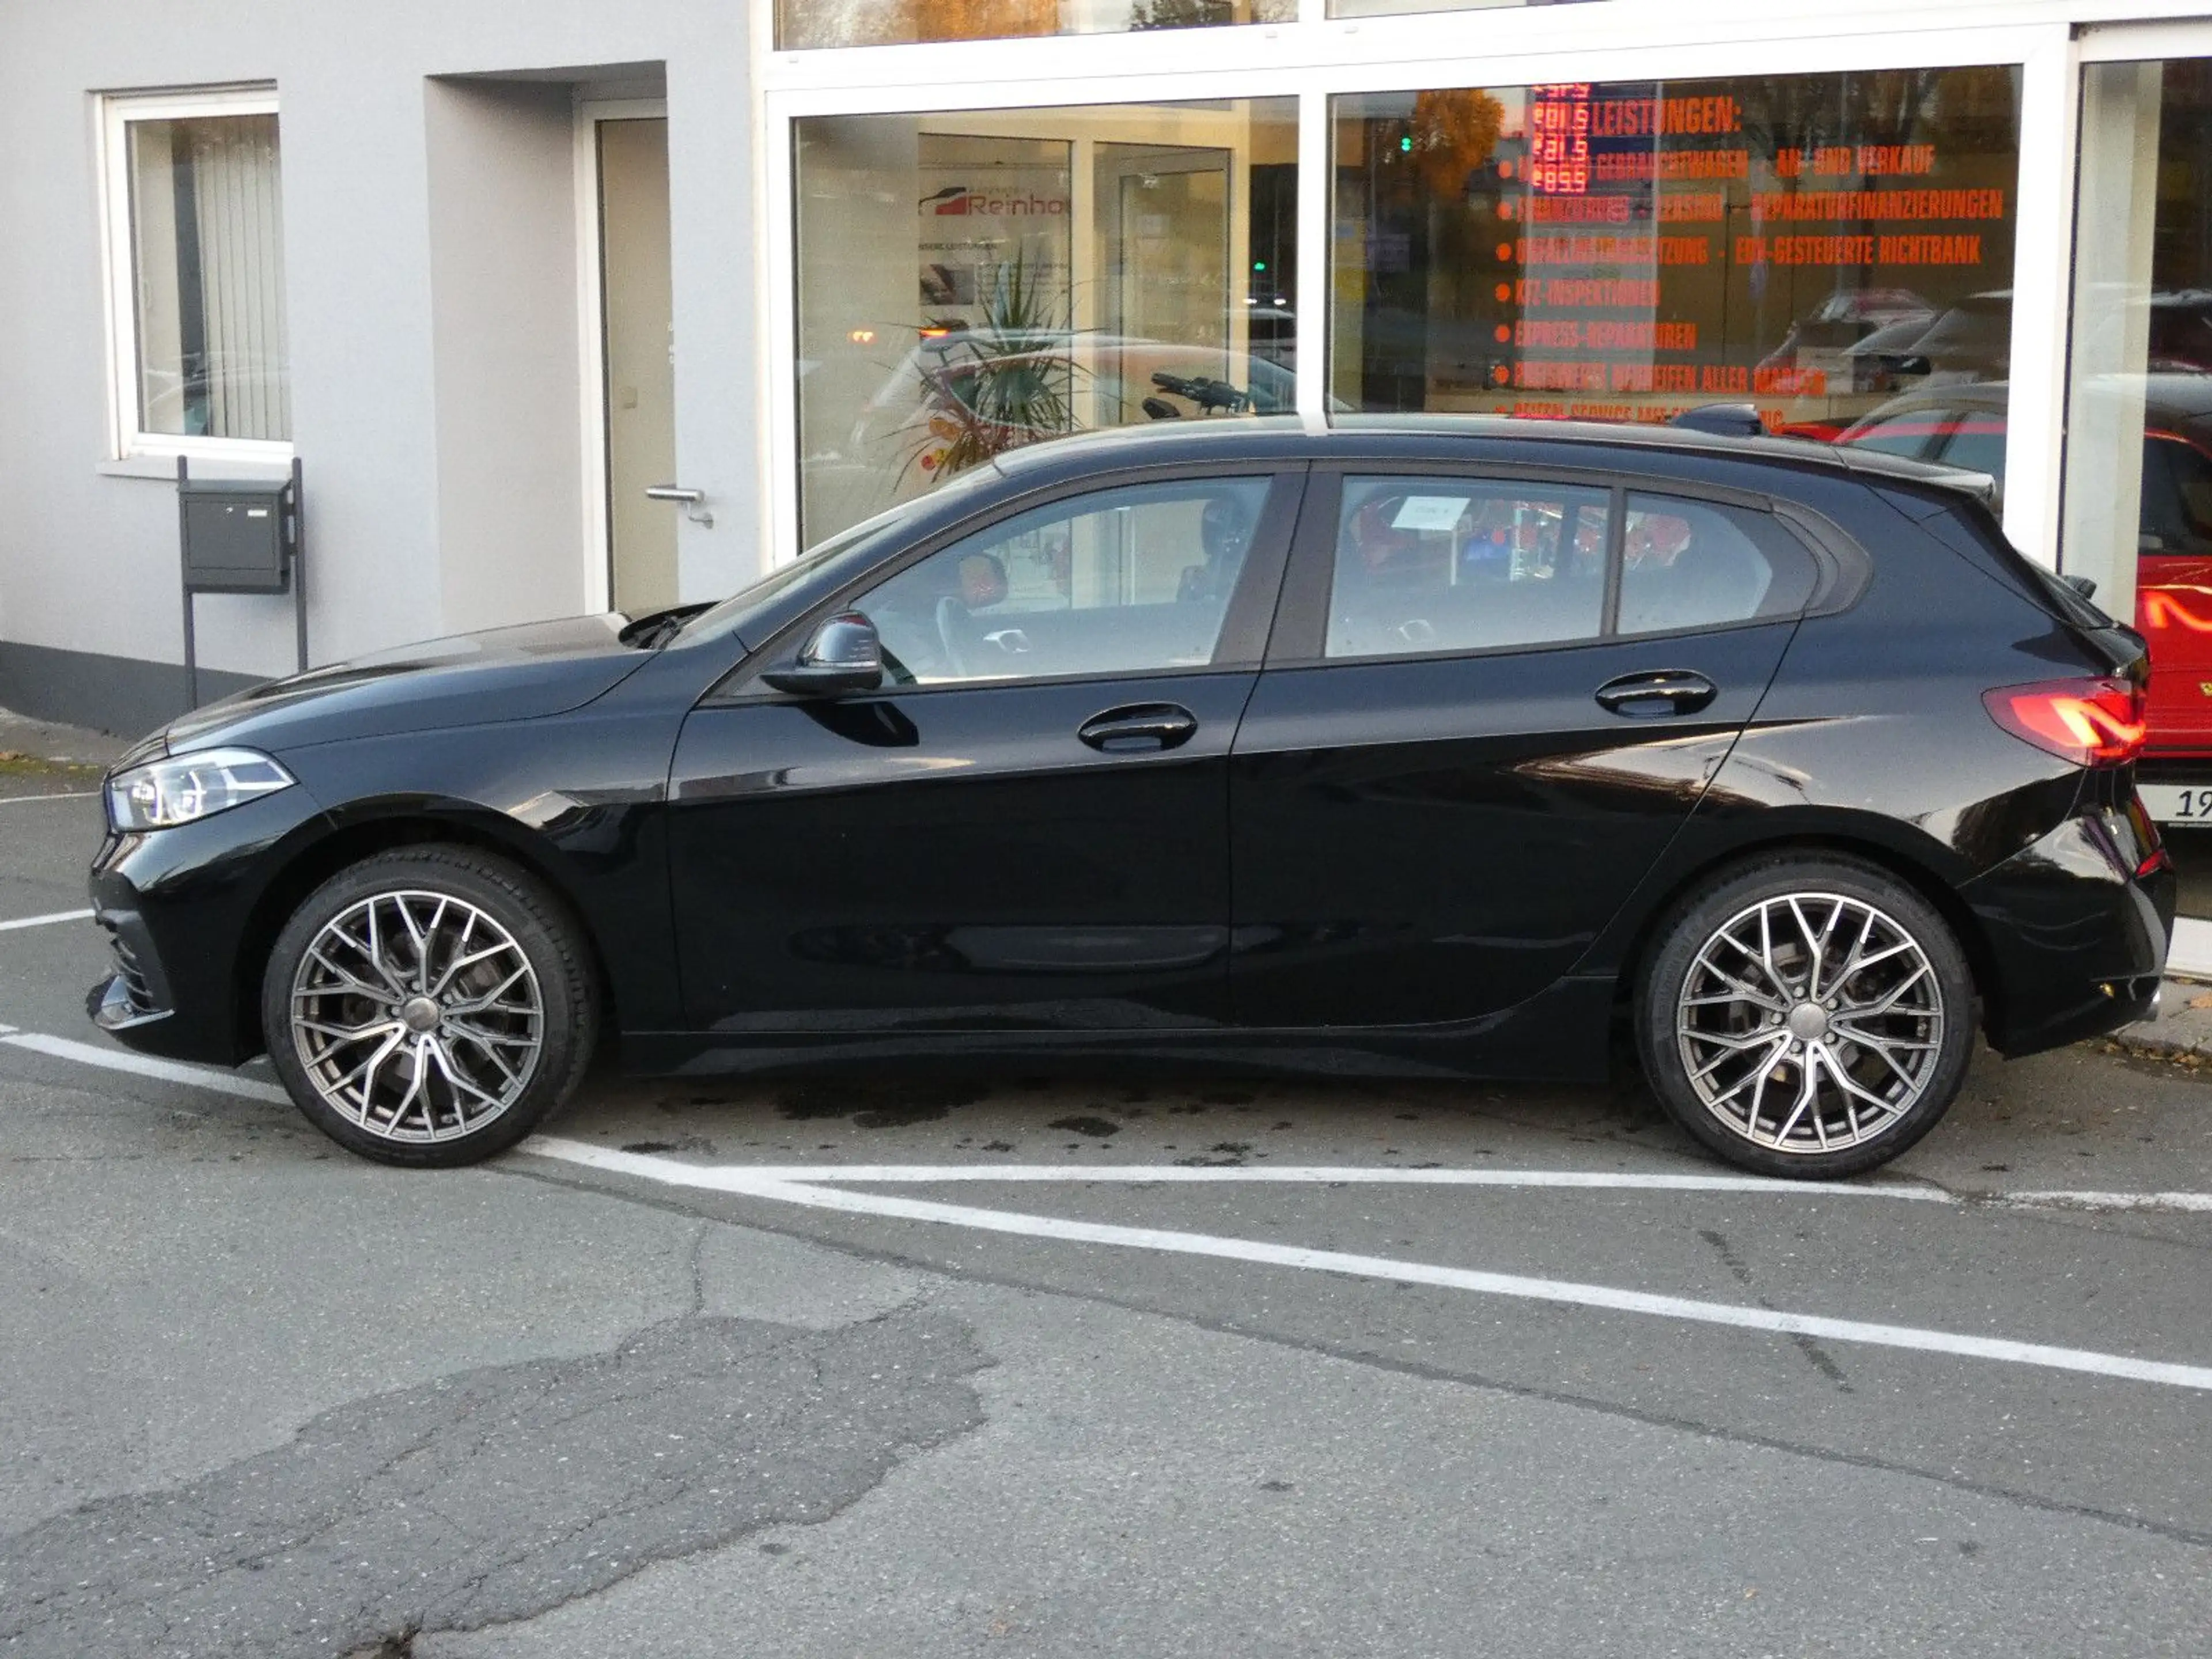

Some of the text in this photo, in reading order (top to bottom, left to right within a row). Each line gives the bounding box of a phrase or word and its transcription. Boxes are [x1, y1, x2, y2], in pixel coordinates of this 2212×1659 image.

[1858, 145, 1934, 174] VERKAUF
[1735, 235, 1873, 265] EDV-GESTEUERTE
[1878, 234, 1982, 265] RICHTBANK
